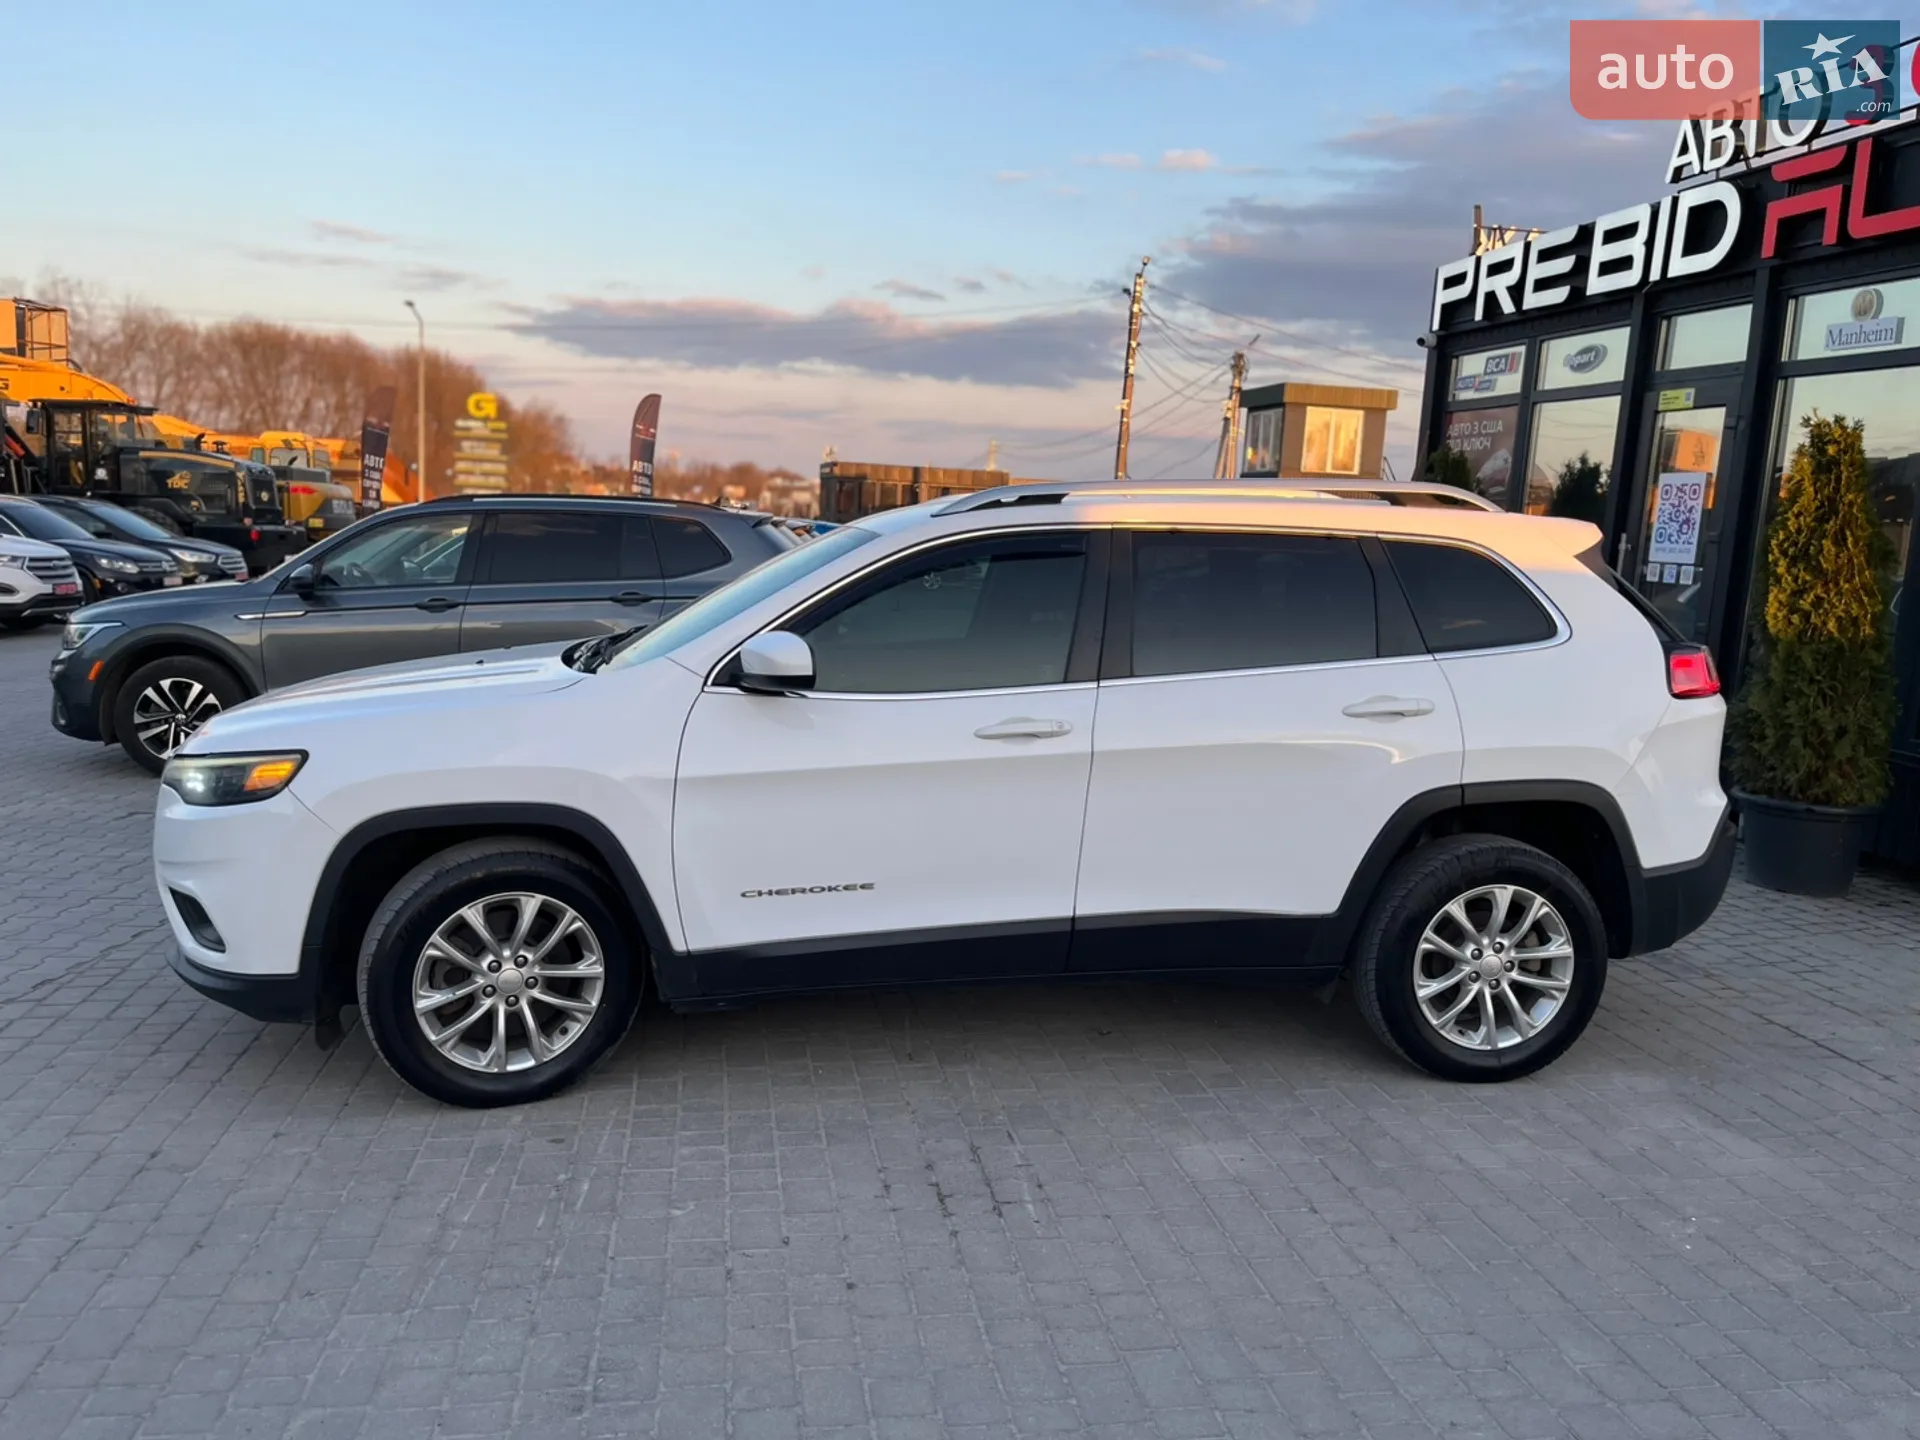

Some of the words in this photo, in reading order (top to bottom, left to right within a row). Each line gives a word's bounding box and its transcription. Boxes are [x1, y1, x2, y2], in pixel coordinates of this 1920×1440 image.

[1432, 181, 1741, 331] PREBID
[1826, 323, 1894, 348] Manheim
[1486, 357, 1506, 373] BCA
[1447, 422, 1471, 437] АВТО
[1481, 420, 1503, 434] США
[1463, 436, 1492, 451] КЛЮЧ
[740, 882, 875, 898] CHEROKEE
